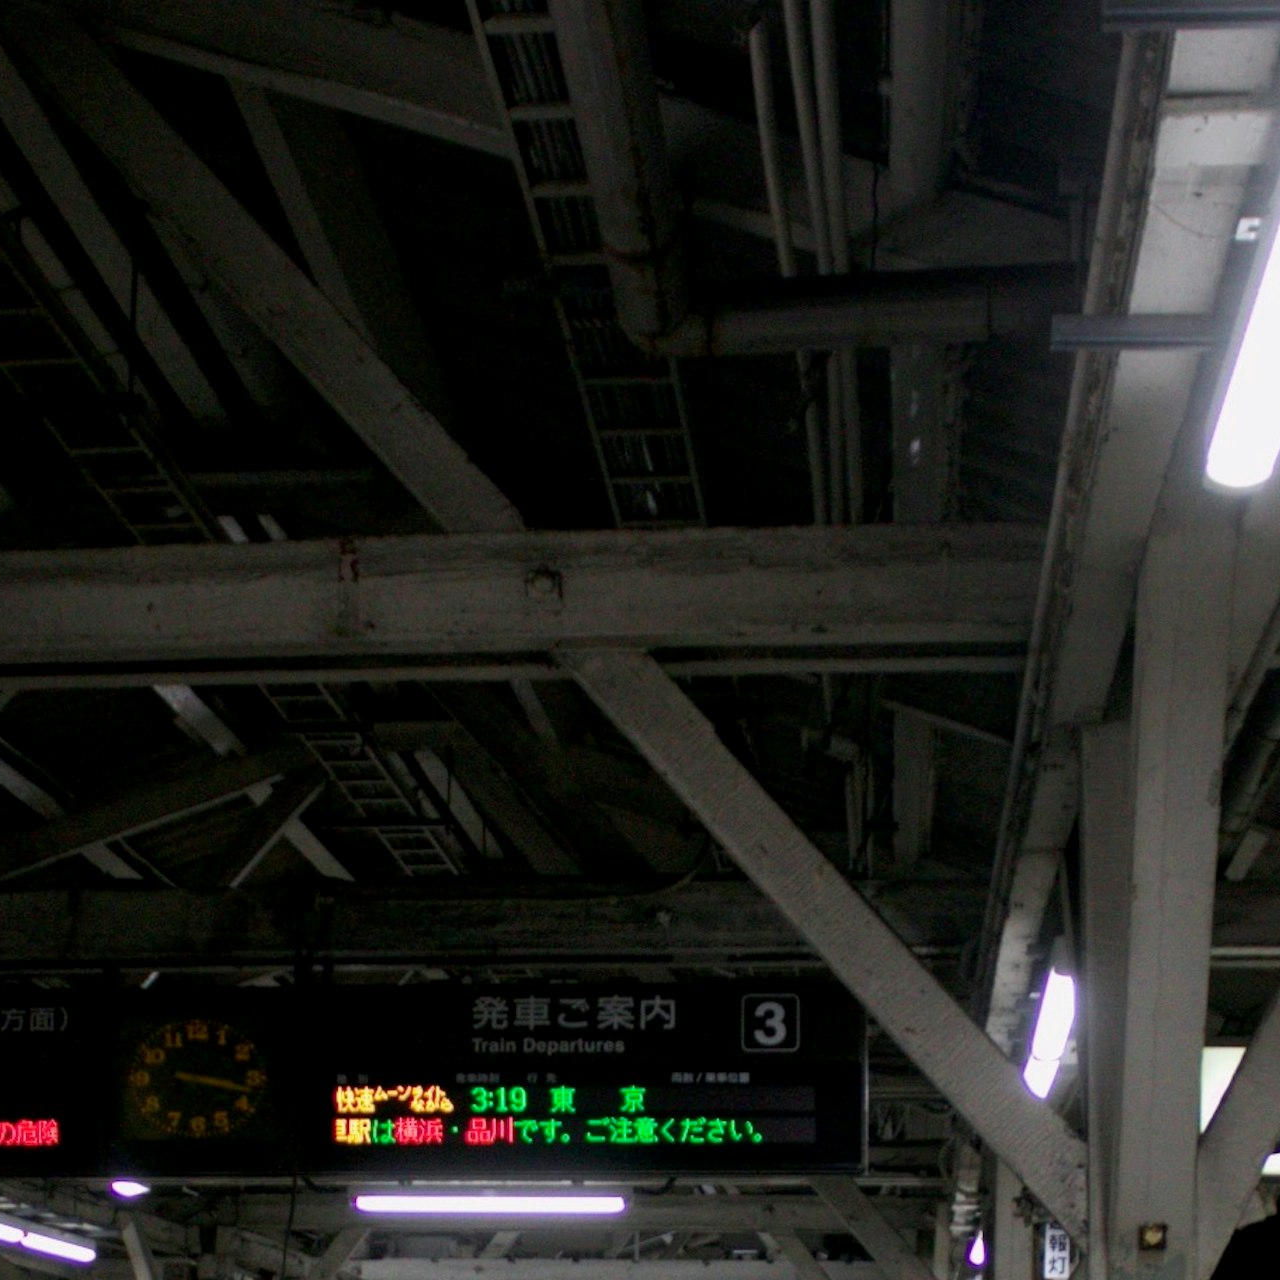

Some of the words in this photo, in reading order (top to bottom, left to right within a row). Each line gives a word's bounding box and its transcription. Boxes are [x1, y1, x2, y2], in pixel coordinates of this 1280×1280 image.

[471, 994, 678, 1032] 発車ご案内
[752, 1000, 788, 1047] 3
[470, 1036, 518, 1054] Train
[521, 1036, 627, 1056] Departures
[333, 1084, 376, 1115] 快速
[468, 1085, 529, 1114] 3:19
